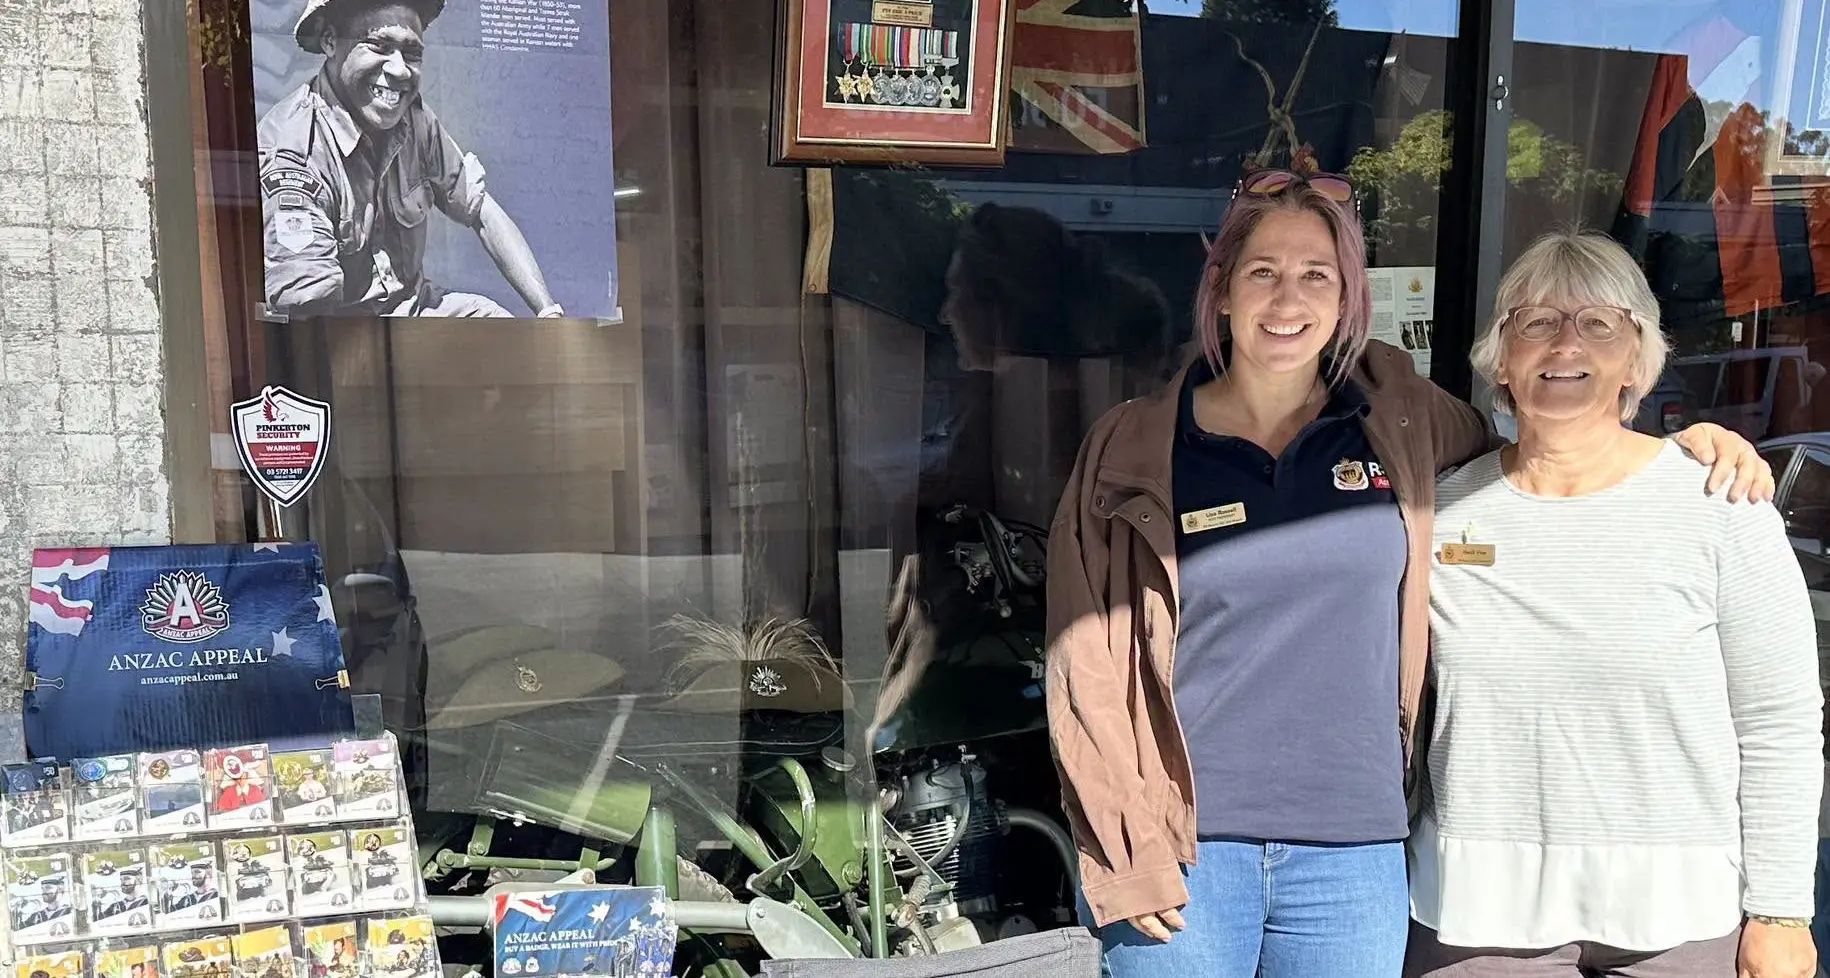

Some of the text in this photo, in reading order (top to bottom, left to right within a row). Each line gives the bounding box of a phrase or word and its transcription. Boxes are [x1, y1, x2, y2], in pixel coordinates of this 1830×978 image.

[545, 32, 558, 40] Navy
[163, 626, 211, 638] ANZAC APPEAL
[108, 648, 268, 671] ANZAC APPEAL
[140, 671, 239, 686] anzacappeal.com.au
[504, 929, 595, 944] ANZAC APPEAL
[551, 942, 570, 950] WEAR
